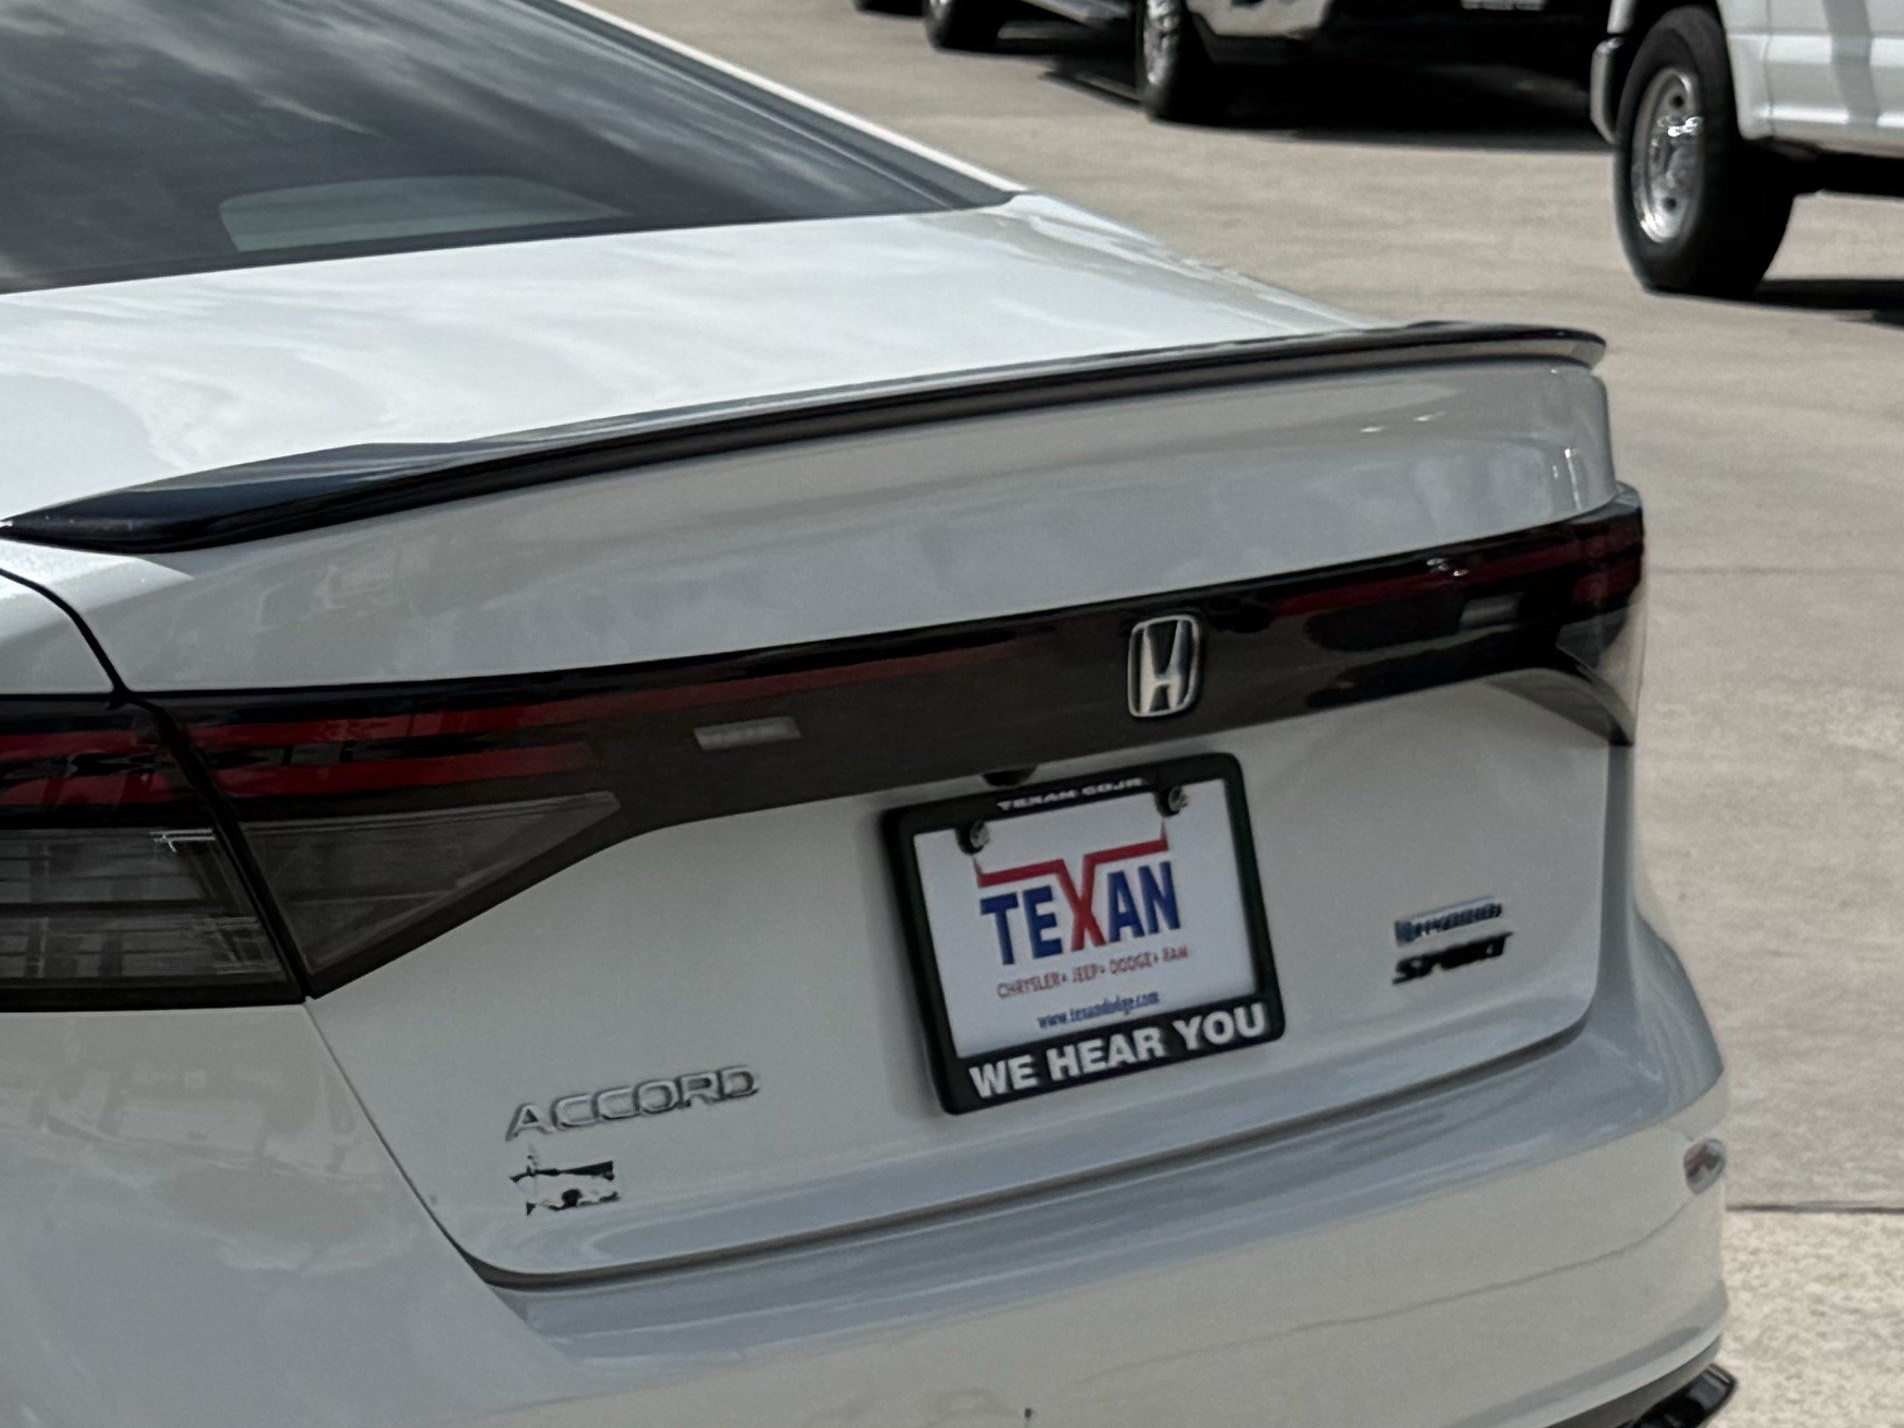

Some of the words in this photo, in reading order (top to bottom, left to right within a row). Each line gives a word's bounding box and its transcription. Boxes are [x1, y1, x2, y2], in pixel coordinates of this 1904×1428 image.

[980, 852, 1180, 966] TEXAN
[997, 972, 1061, 998] CHRYSLER
[1072, 964, 1098, 984] JEEP
[1109, 952, 1153, 974] DODGE
[1163, 946, 1189, 962] RAM
[969, 1055, 1039, 1099] WE
[1046, 1027, 1166, 1081] HEAR
[1173, 1002, 1267, 1051] YOU
[505, 1065, 761, 1142] ACCORD
